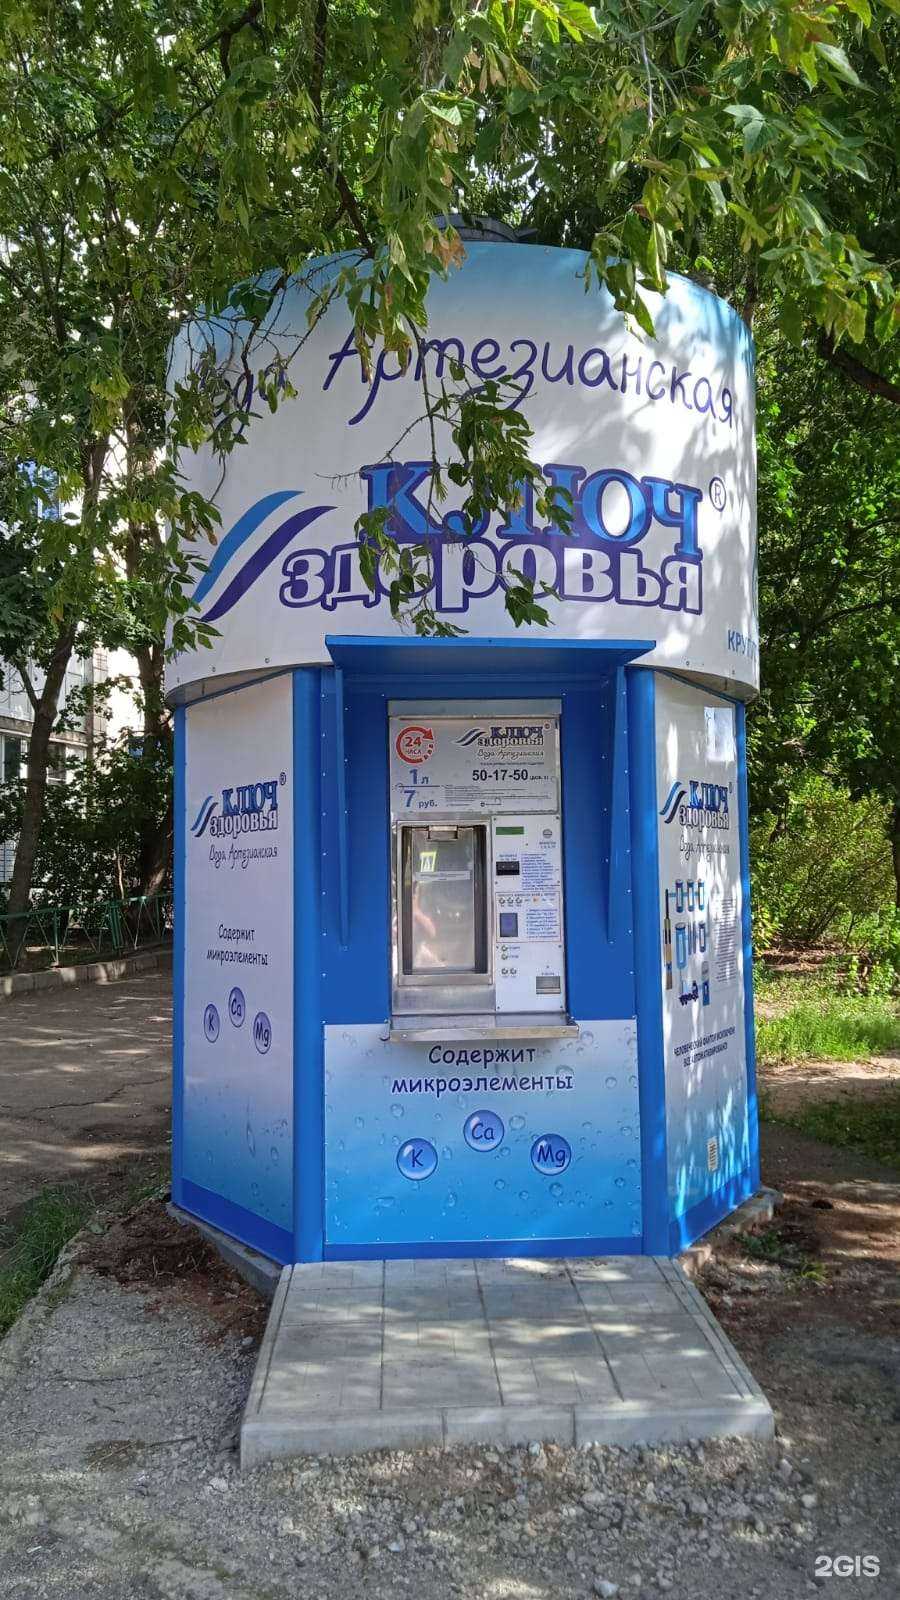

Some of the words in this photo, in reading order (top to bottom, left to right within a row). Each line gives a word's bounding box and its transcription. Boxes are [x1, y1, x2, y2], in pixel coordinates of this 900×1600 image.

[322, 326, 733, 428] Артезианская
[405, 736, 422, 747] 24
[409, 768, 418, 785] 1
[421, 775, 429, 784] л
[472, 769, 528, 781] 50-17-50
[222, 780, 278, 817] КЛЮЧ
[404, 789, 416, 807] 7
[418, 800, 438, 809] руб.
[218, 923, 255, 944] Содержит
[206, 949, 269, 966] микроэлементы
[231, 998, 242, 1016] Ca
[208, 1013, 214, 1032] K
[256, 1021, 270, 1048] Mg
[428, 1045, 536, 1069] Содержит
[391, 1074, 574, 1098] микроэлементы
[471, 1123, 495, 1141] Ca
[411, 1148, 424, 1168] K
[537, 1145, 566, 1168] Mg
